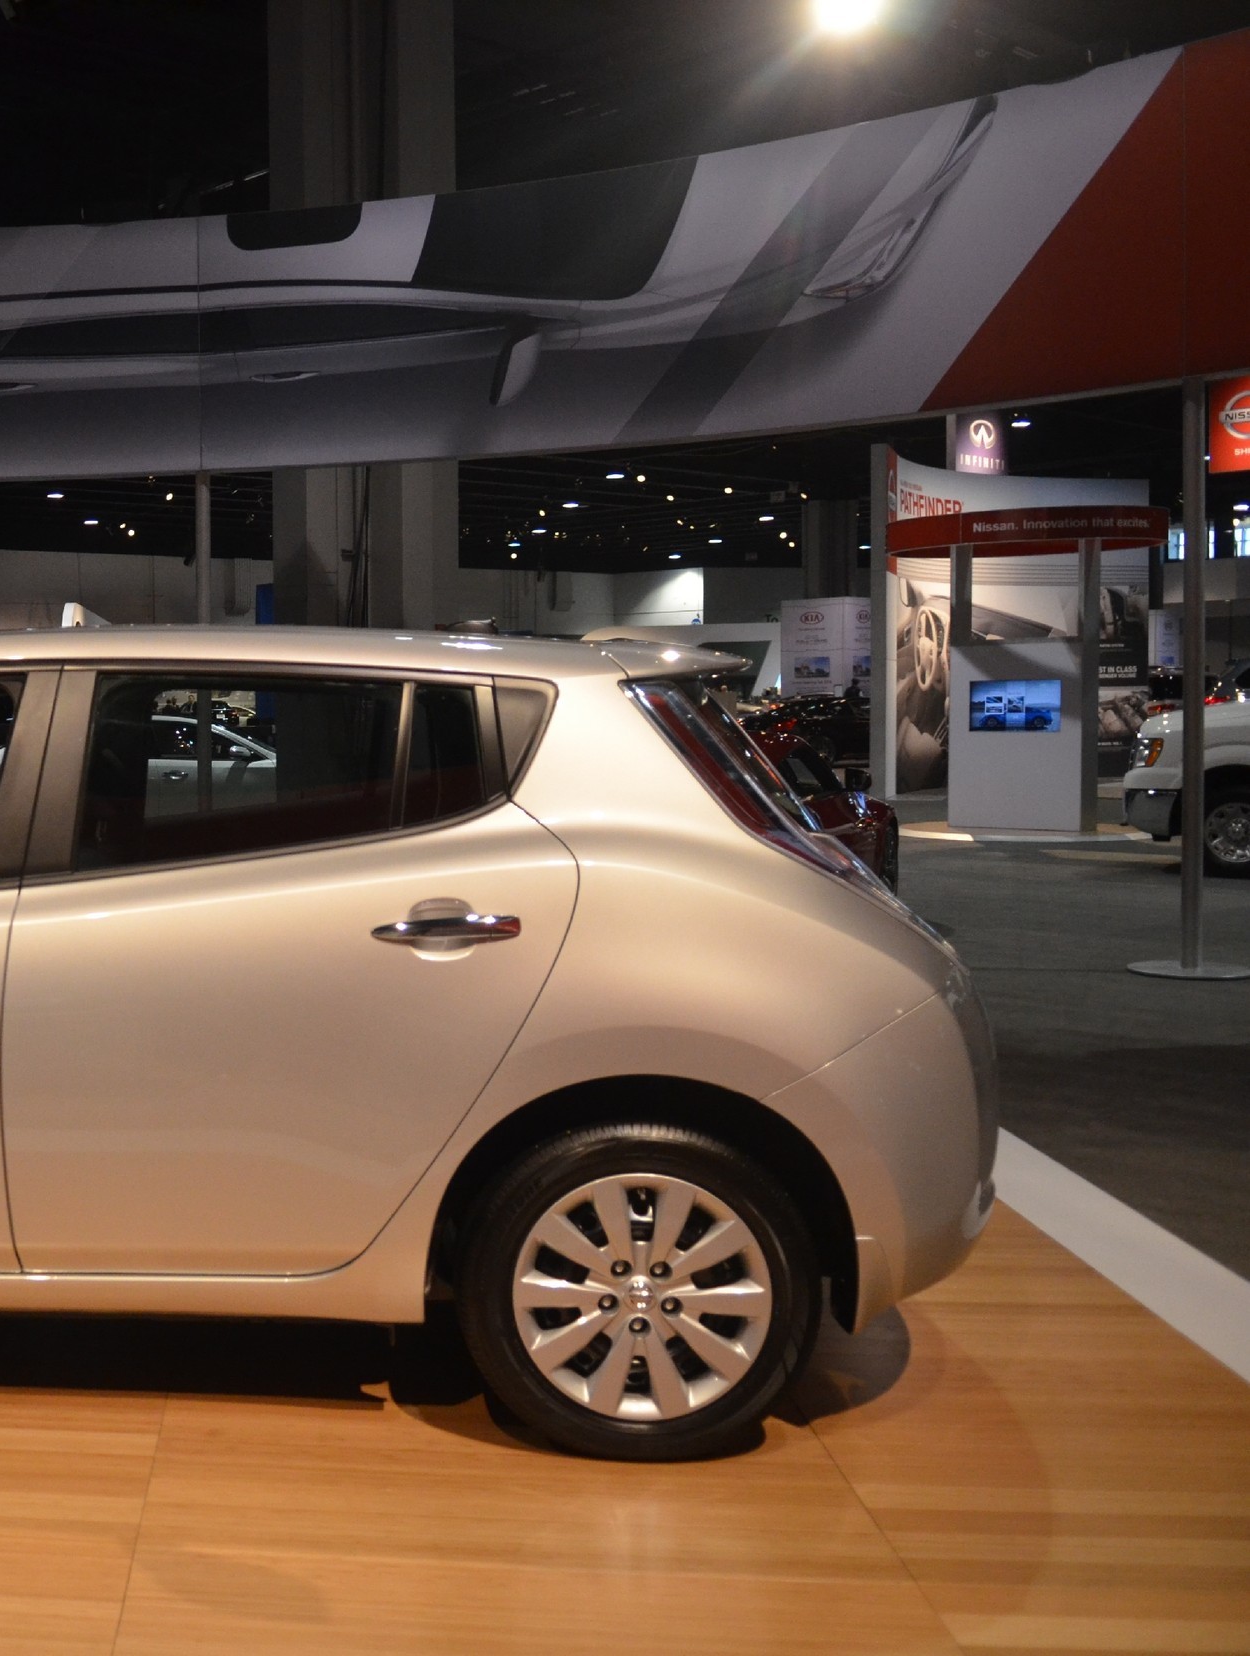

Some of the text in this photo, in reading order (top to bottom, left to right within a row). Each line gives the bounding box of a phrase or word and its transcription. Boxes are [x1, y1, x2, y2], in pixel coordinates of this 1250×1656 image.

[960, 453, 1005, 470] INFINITI
[973, 521, 1019, 533] Nissan.
[1023, 519, 1088, 530] Innovation
[1092, 517, 1114, 528] that
